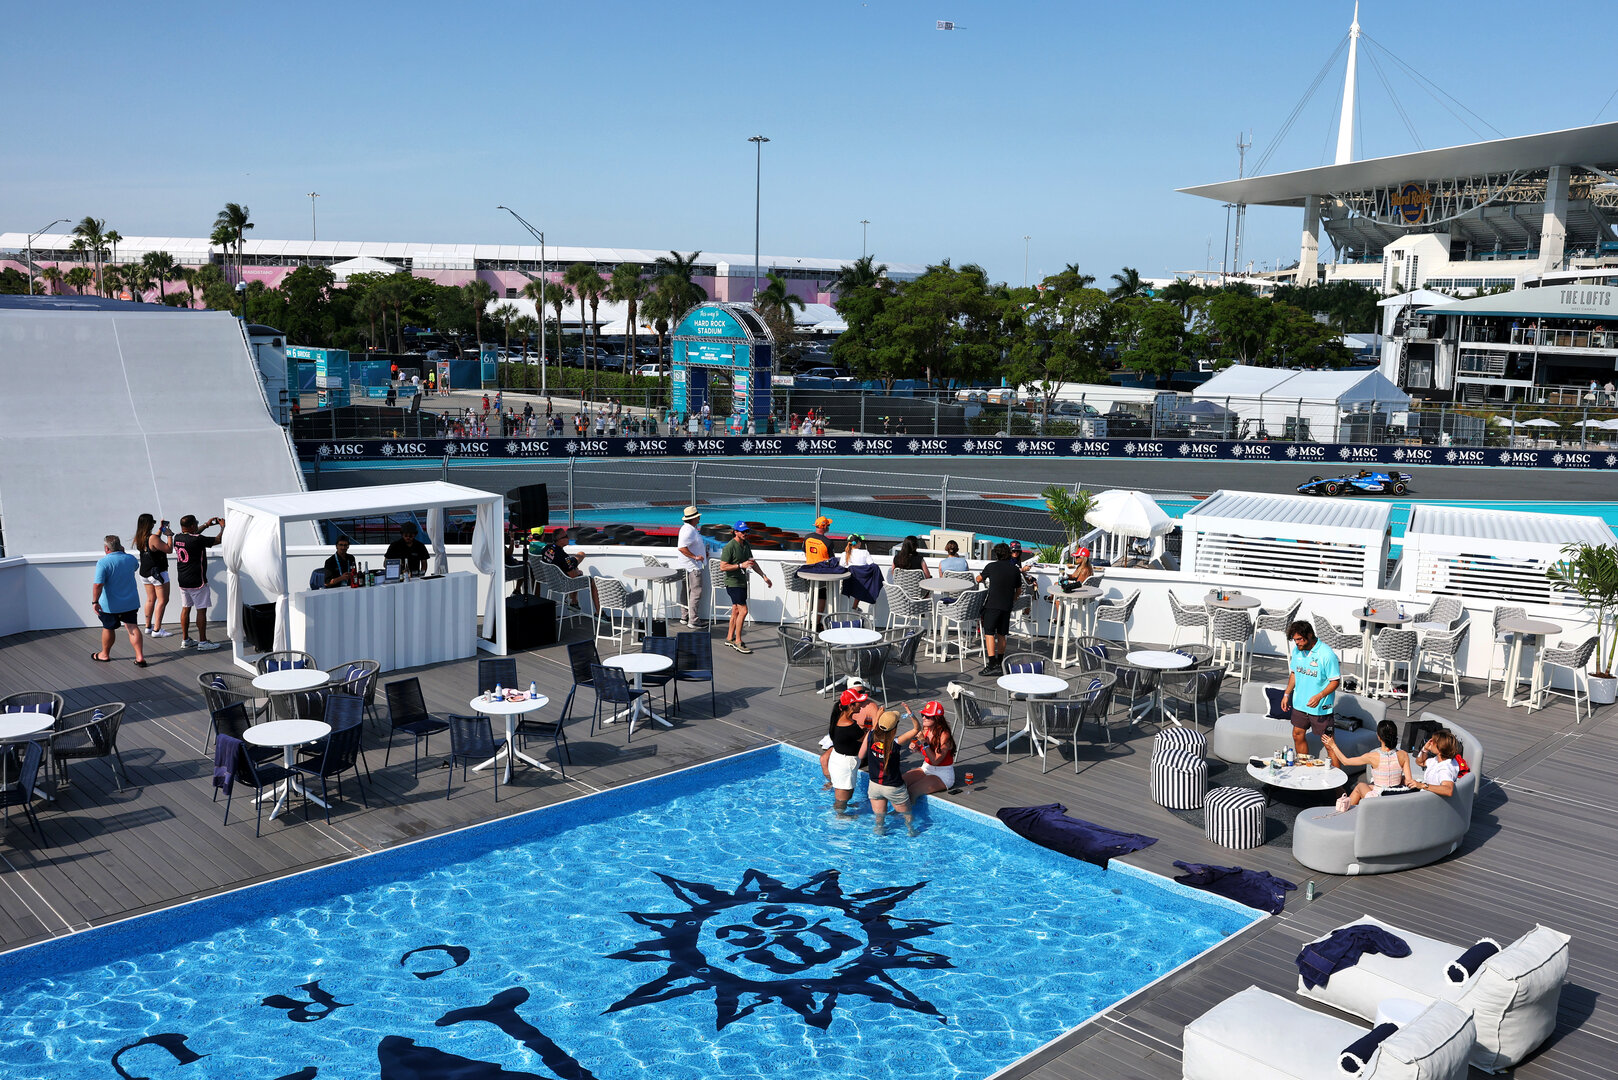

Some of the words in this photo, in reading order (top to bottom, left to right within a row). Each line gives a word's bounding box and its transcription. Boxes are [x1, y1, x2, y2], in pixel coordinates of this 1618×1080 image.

[1561, 290, 1578, 304] THE
[1580, 291, 1611, 305] LOFTS
[297, 350, 311, 358] BRIDGE
[396, 443, 426, 453] MSC
[460, 443, 489, 452] MSC
[519, 442, 549, 451] MSC
[578, 441, 608, 450] MSC
[638, 441, 667, 450] MSC
[697, 440, 725, 449] MSC
[755, 440, 782, 449] MSC
[810, 440, 837, 449] MSC
[866, 440, 893, 449] MSC
[921, 440, 948, 449] MSC
[976, 441, 1003, 449] MSC
[1029, 441, 1056, 450] MSC
[1084, 442, 1110, 451] MSC
[1137, 443, 1163, 452] MSC
[1191, 444, 1218, 453] MSC
[333, 445, 364, 455] MSC
[1245, 445, 1271, 454] MSC
[1299, 447, 1325, 456] MSC
[1352, 448, 1378, 457] MSC
[1406, 449, 1432, 459] MSC
[1459, 451, 1485, 460] MSC
[1512, 453, 1538, 462] MSC
[1565, 454, 1591, 463] MSC
